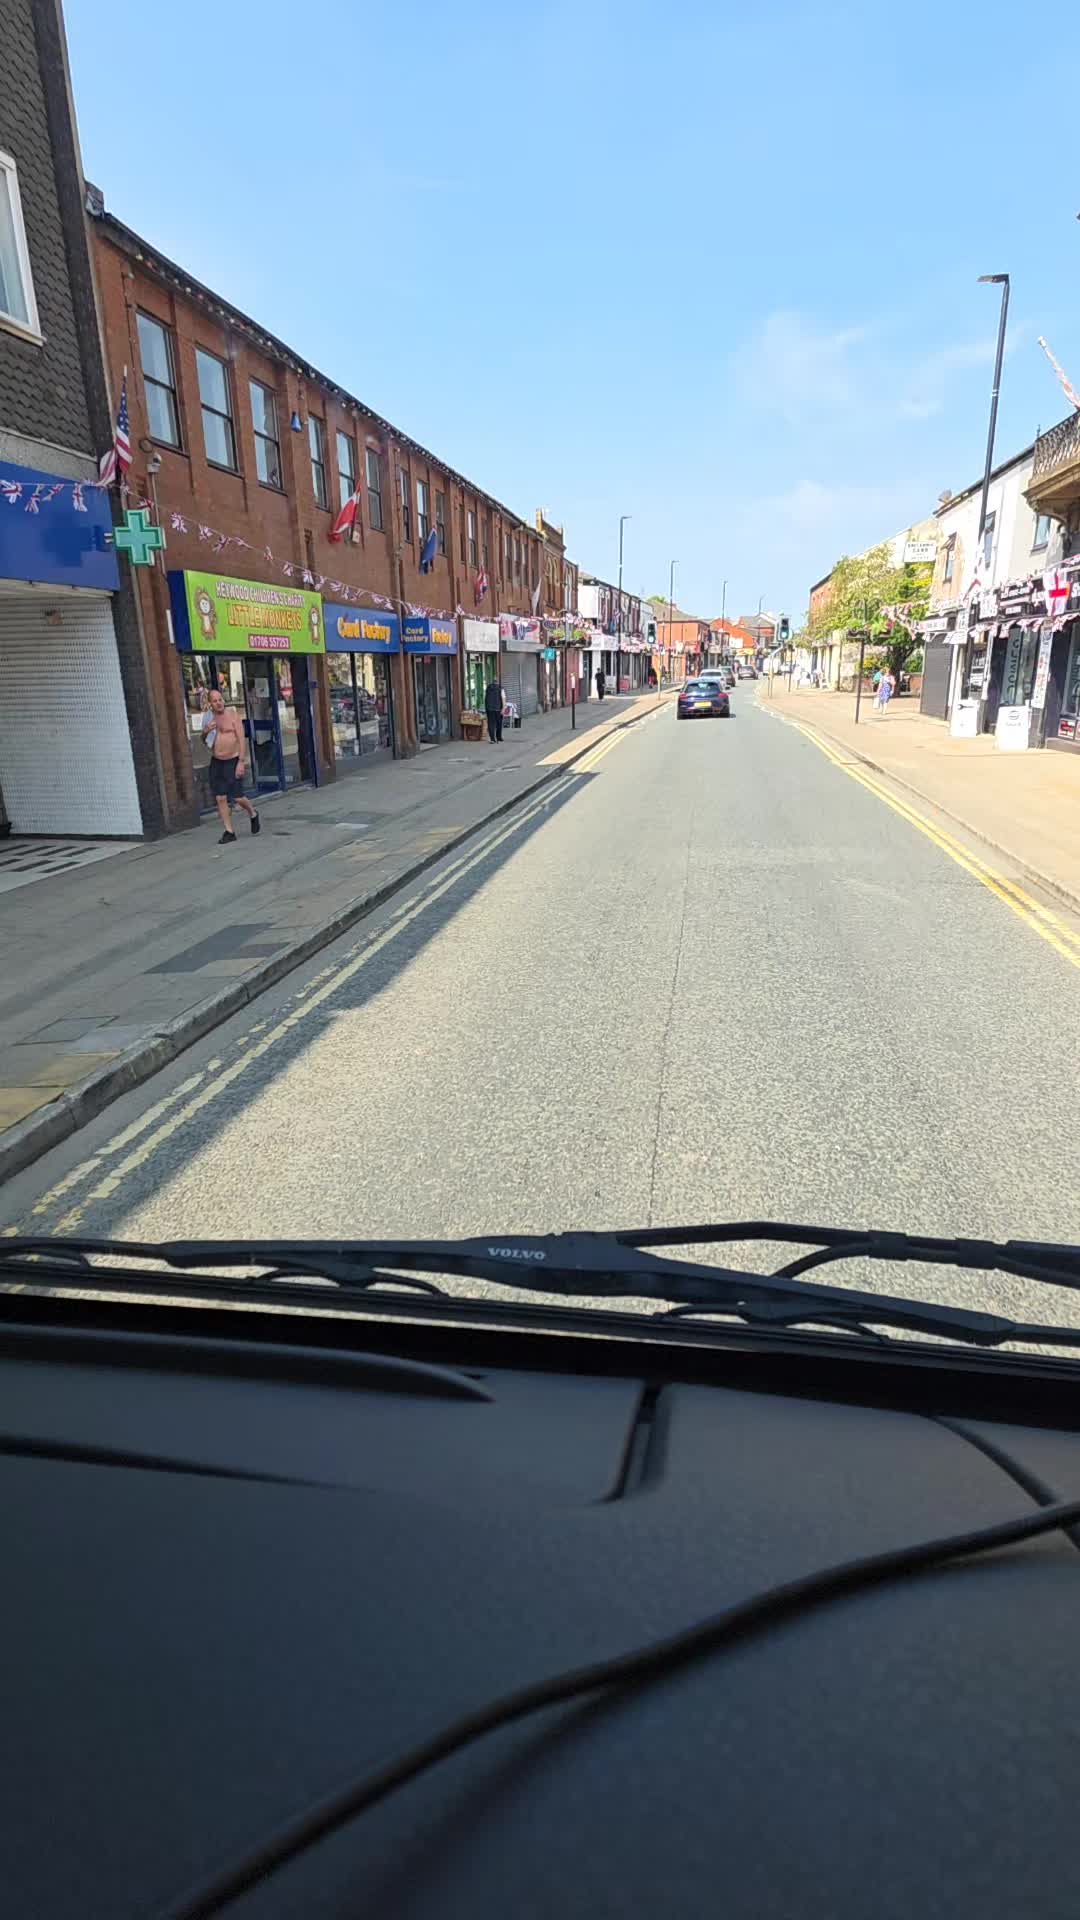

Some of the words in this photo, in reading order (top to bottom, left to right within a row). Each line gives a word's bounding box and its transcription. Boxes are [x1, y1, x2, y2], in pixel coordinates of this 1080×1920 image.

[216, 581, 249, 601] HEYWOOD
[229, 603, 262, 628] LITTLE
[262, 608, 303, 631] MONKEYS
[337, 616, 359, 638] Card
[361, 620, 391, 644] Factory
[405, 627, 424, 635] Card
[249, 635, 269, 648] 01706
[488, 1247, 547, 1260] VOLVO
